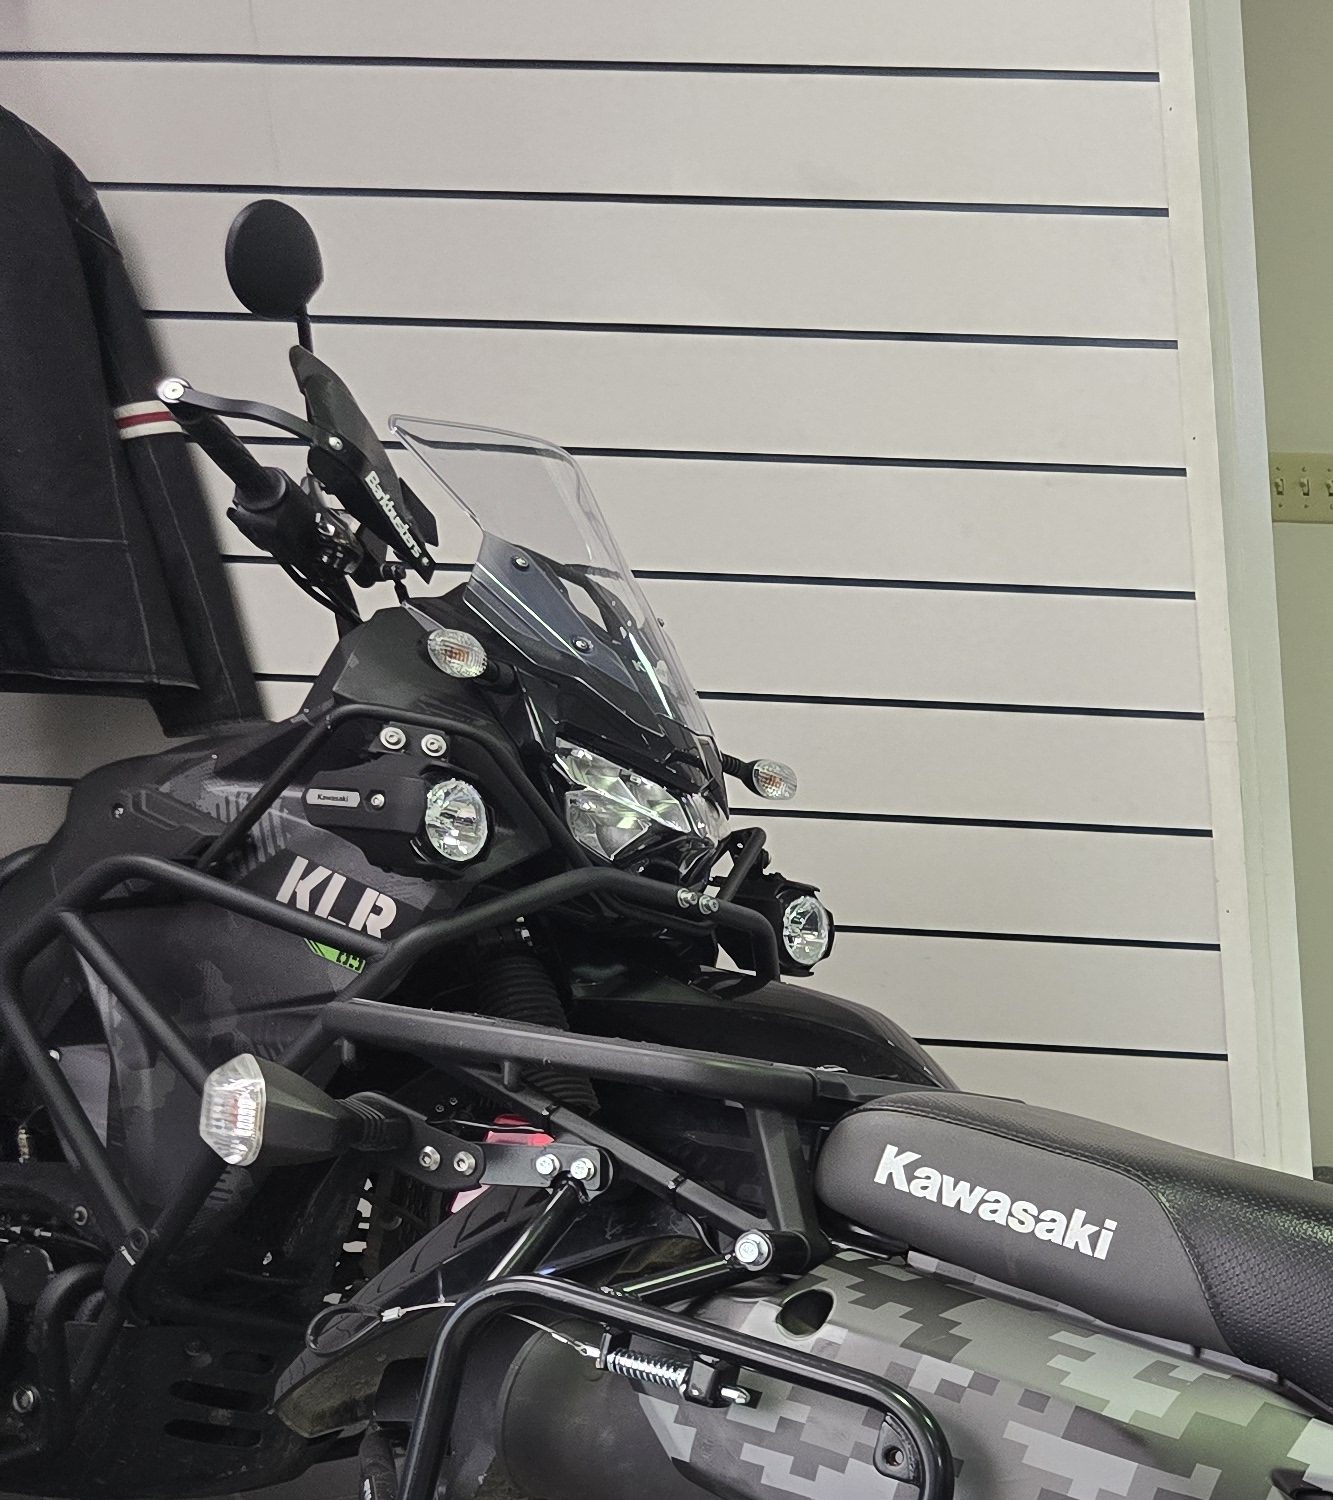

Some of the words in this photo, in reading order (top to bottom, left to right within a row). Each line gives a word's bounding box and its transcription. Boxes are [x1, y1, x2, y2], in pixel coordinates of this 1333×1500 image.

[364, 470, 422, 557] Barkbusters
[316, 793, 349, 802] Kawasaki
[275, 855, 397, 939] KLR
[874, 1144, 1118, 1260] Kawasaki
